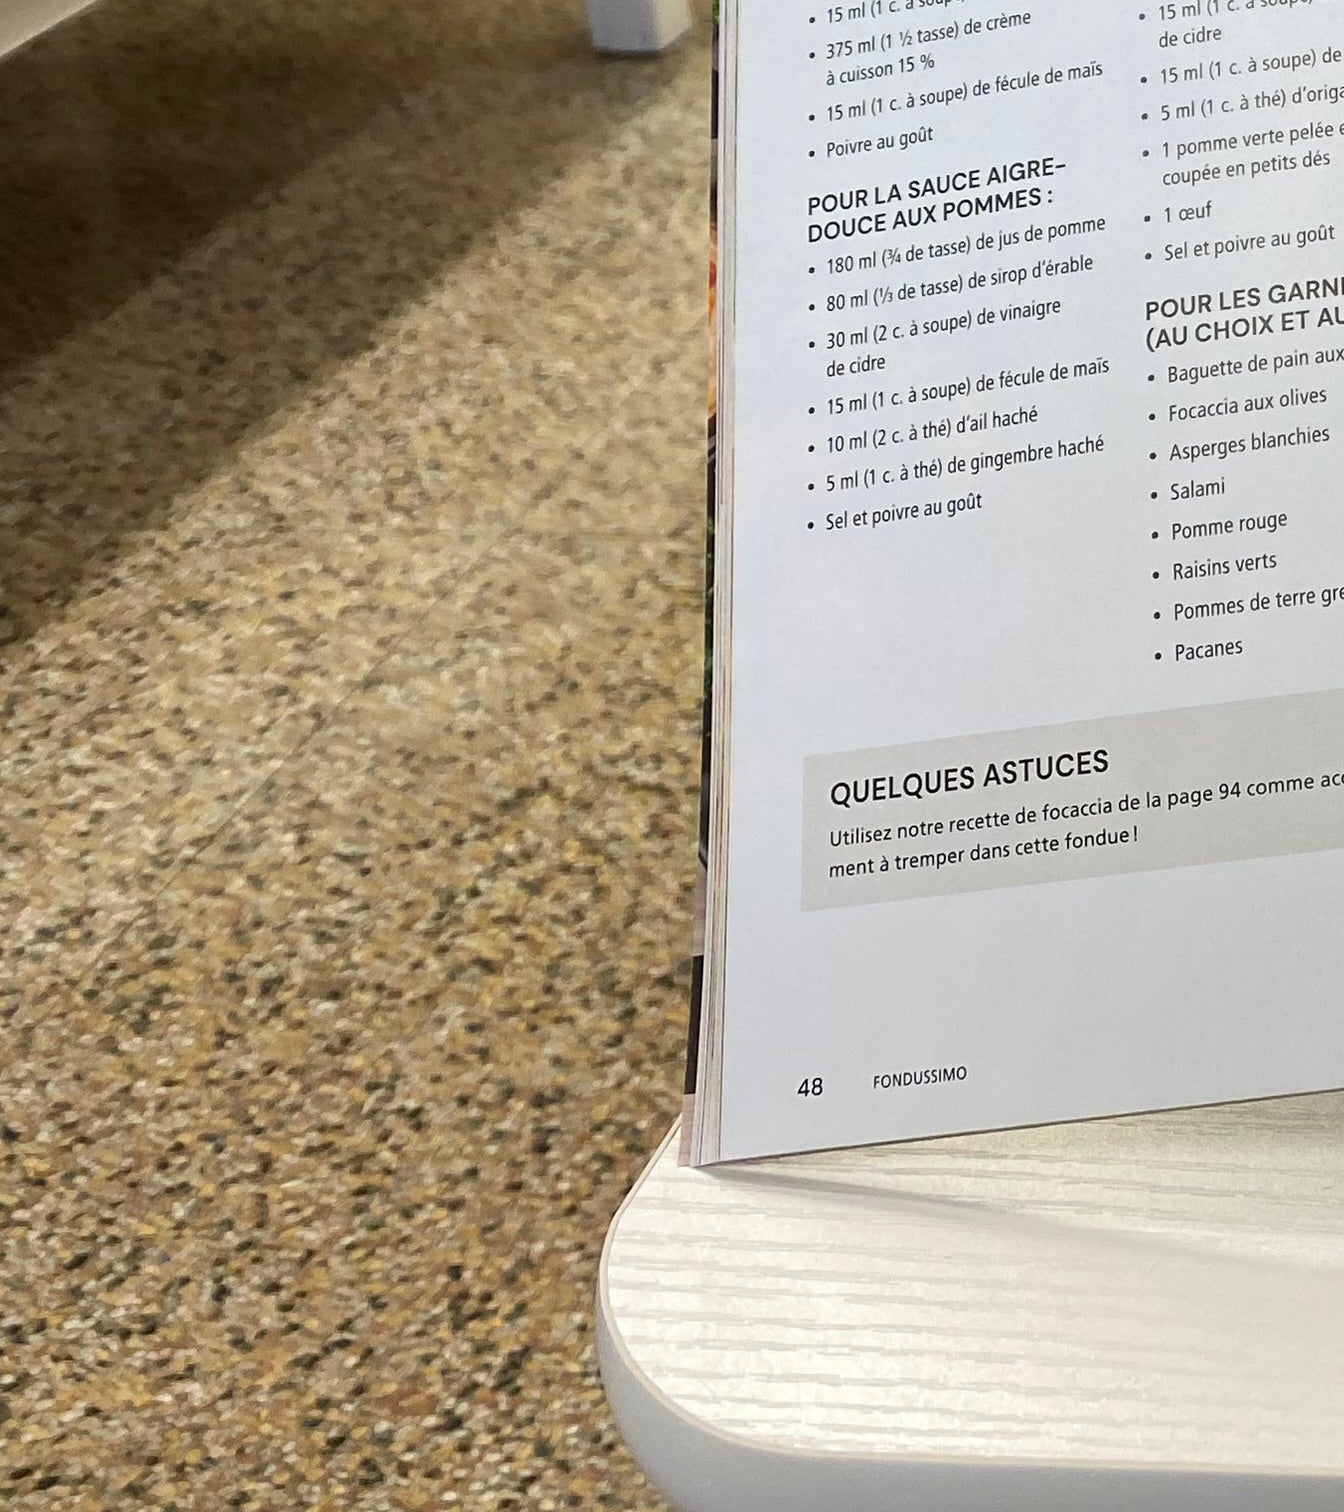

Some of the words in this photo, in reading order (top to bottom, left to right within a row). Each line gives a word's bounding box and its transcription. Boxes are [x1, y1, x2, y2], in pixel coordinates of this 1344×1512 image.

[826, 70, 835, 86] à
[839, 63, 893, 84] cuisson
[898, 56, 915, 73] 15
[919, 52, 935, 70] %
[826, 139, 873, 158] Poivre
[876, 135, 895, 150] au
[899, 126, 934, 151] goût
[808, 189, 868, 216] POUR
[874, 183, 902, 205] LA
[907, 169, 981, 199] SAUCE
[986, 156, 1067, 187] AIGRE-
[808, 212, 887, 243] DOUCE
[892, 204, 937, 230] AUX
[943, 187, 1042, 222] POMMES
[1164, 206, 1171, 223] 1
[1178, 199, 1212, 222] œuf
[1164, 241, 1188, 262] Sel
[1193, 241, 1210, 257] et
[1214, 234, 1266, 259] poivre
[1270, 232, 1291, 247] au
[1296, 223, 1335, 249] goût
[1145, 294, 1212, 321] POUR
[1219, 287, 1261, 311] LES
[1146, 325, 1188, 353] (AU
[1194, 314, 1274, 343] CHOIX
[1281, 309, 1311, 332] ET
[1167, 359, 1243, 385] Baguette
[1247, 353, 1268, 373] de
[1273, 349, 1309, 374] pain
[1168, 397, 1239, 422] Focaccia
[1243, 395, 1275, 413] aux
[1279, 387, 1328, 408] olives
[1169, 438, 1246, 464] Asperges
[1251, 426, 1330, 451] blanchies
[1170, 476, 1225, 501] Salami
[1171, 520, 1234, 541] Pomme
[1239, 513, 1288, 534] rouge
[1173, 558, 1231, 581] Raisins
[1235, 553, 1278, 573] verts
[1174, 599, 1245, 621] Pommes
[1249, 591, 1271, 612] de
[1275, 590, 1316, 608] terre
[1175, 640, 1243, 662] Pacanes
[830, 766, 975, 809] QUELQUES
[982, 749, 1109, 788] ASTUCES
[830, 827, 893, 847] Utilisez
[897, 821, 944, 839] notre
[949, 812, 1010, 833] recette
[1015, 806, 1037, 825] de
[1041, 797, 1113, 822] focaccia
[1118, 793, 1141, 812] de
[1146, 791, 1162, 809] la
[1167, 788, 1213, 811] page
[1218, 781, 1242, 800] 94
[1246, 776, 1315, 797] comme
[829, 858, 875, 878] ment
[879, 855, 889, 872] à
[894, 849, 965, 871] tremper
[969, 843, 1011, 862] dans
[1015, 837, 1060, 856] cette
[797, 1077, 823, 1097] 48
[873, 1065, 968, 1089] FONDUSSIMO
